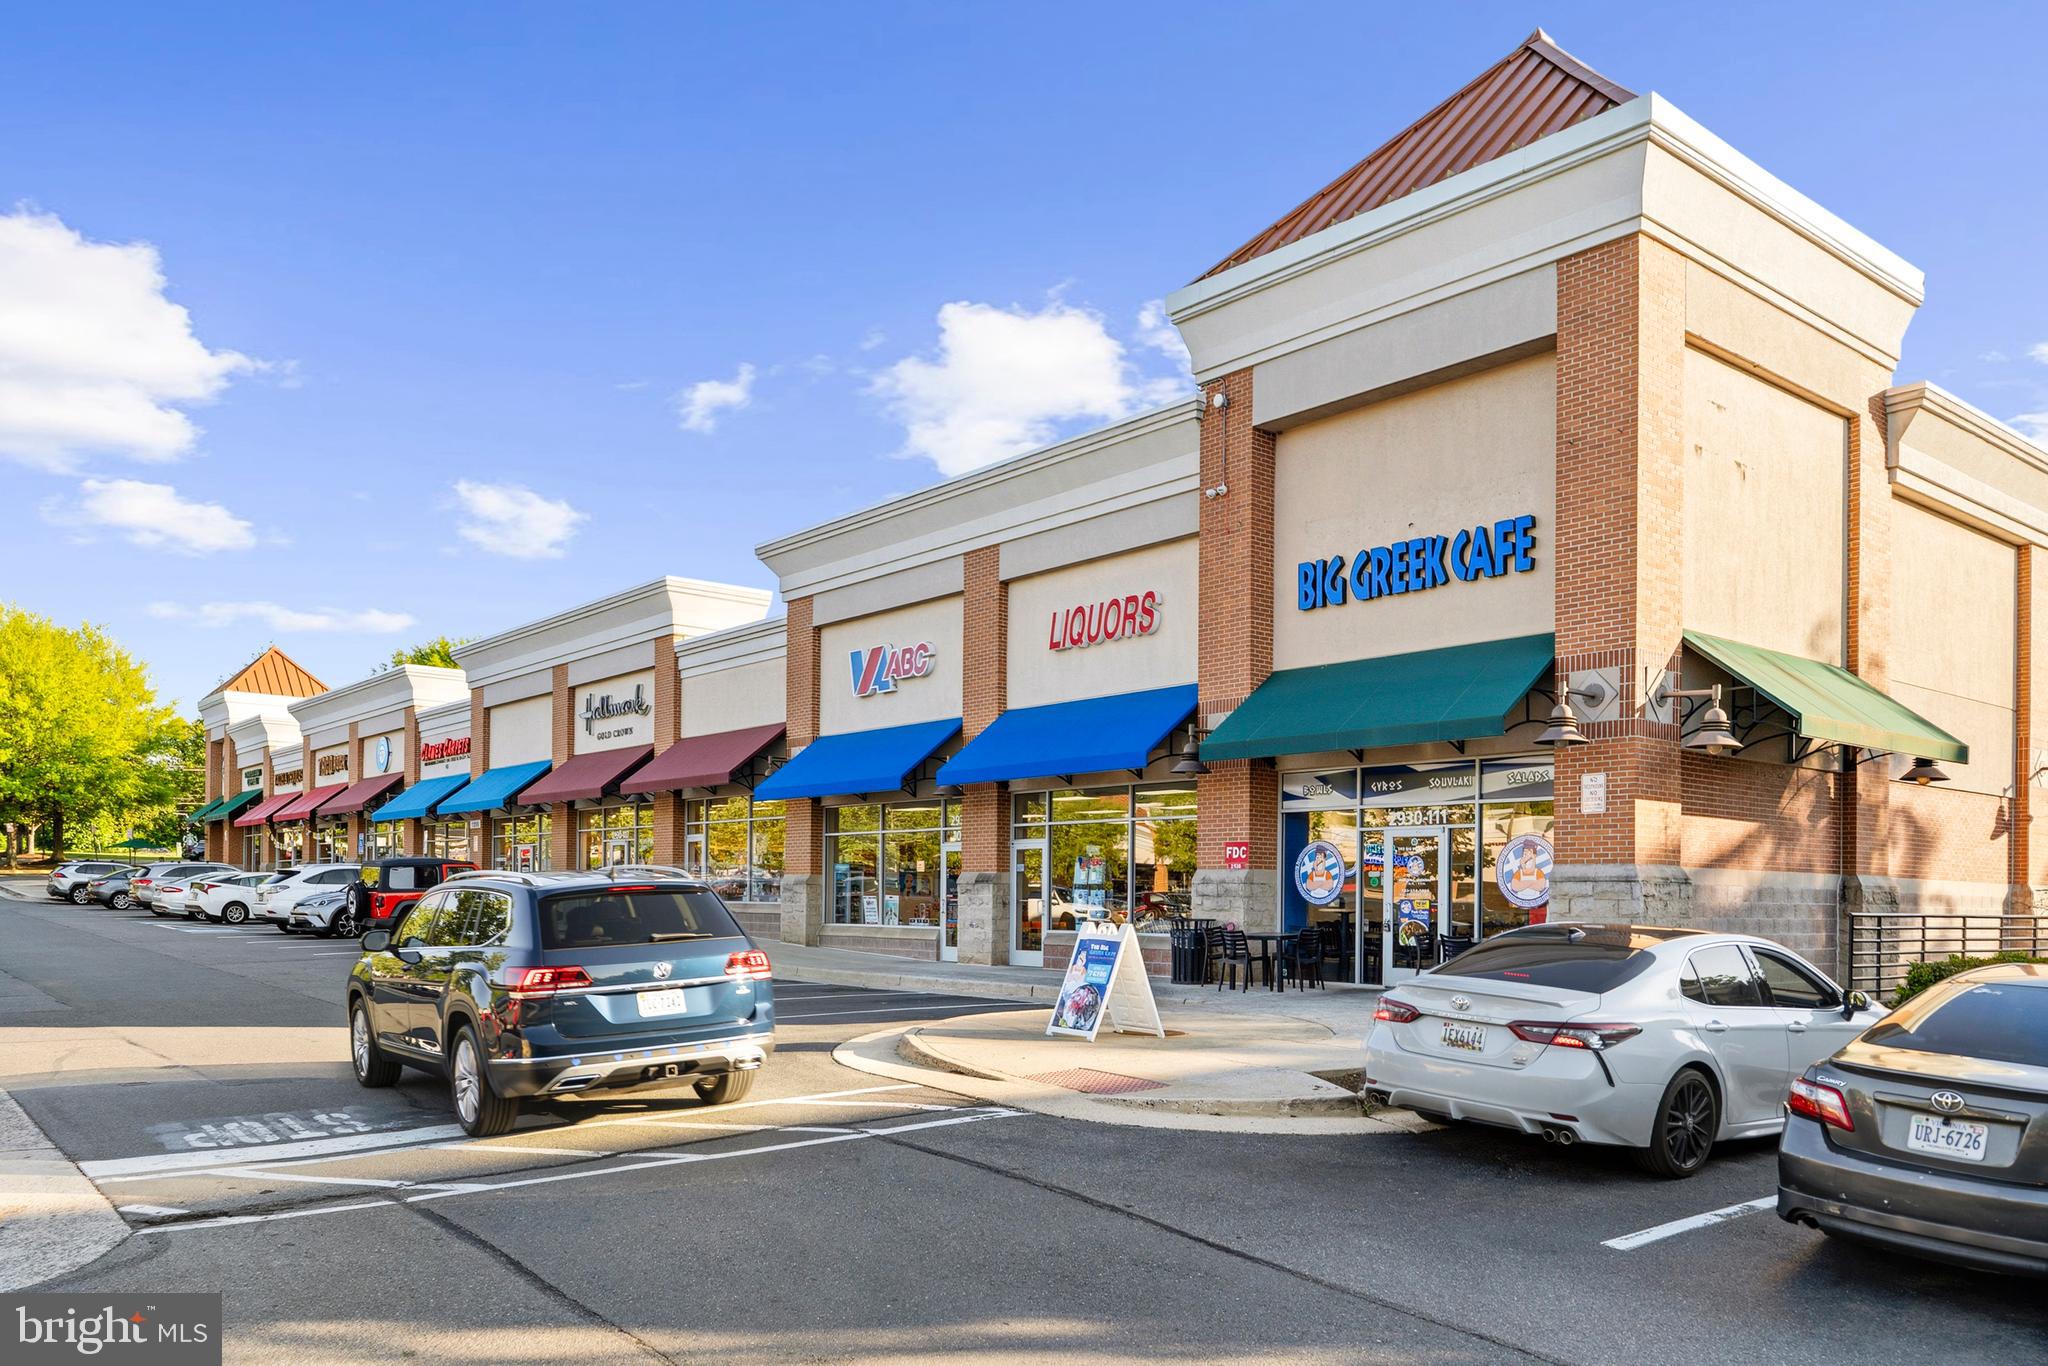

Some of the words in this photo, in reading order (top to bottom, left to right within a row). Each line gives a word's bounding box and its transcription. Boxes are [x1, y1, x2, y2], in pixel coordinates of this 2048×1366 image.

[1298, 554, 1347, 611] BIG
[1349, 534, 1449, 601] GREEK
[1450, 514, 1536, 581] CAFE
[1049, 590, 1162, 651] LIQUORS
[579, 684, 652, 736] Hallmark
[596, 730, 612, 740] GOLD
[613, 726, 633, 738] CROWN
[1429, 776, 1472, 789] SOUVLAKI
[1508, 770, 1549, 784] SALADS
[1303, 784, 1333, 796] BOWLS
[1371, 780, 1402, 792] GYROS
[1388, 808, 1448, 826] 2930-111
[1226, 846, 1247, 859] FDC
[1931, 1119, 1968, 1131] VIINIA
[1915, 1124, 1982, 1150] URJ-6726
